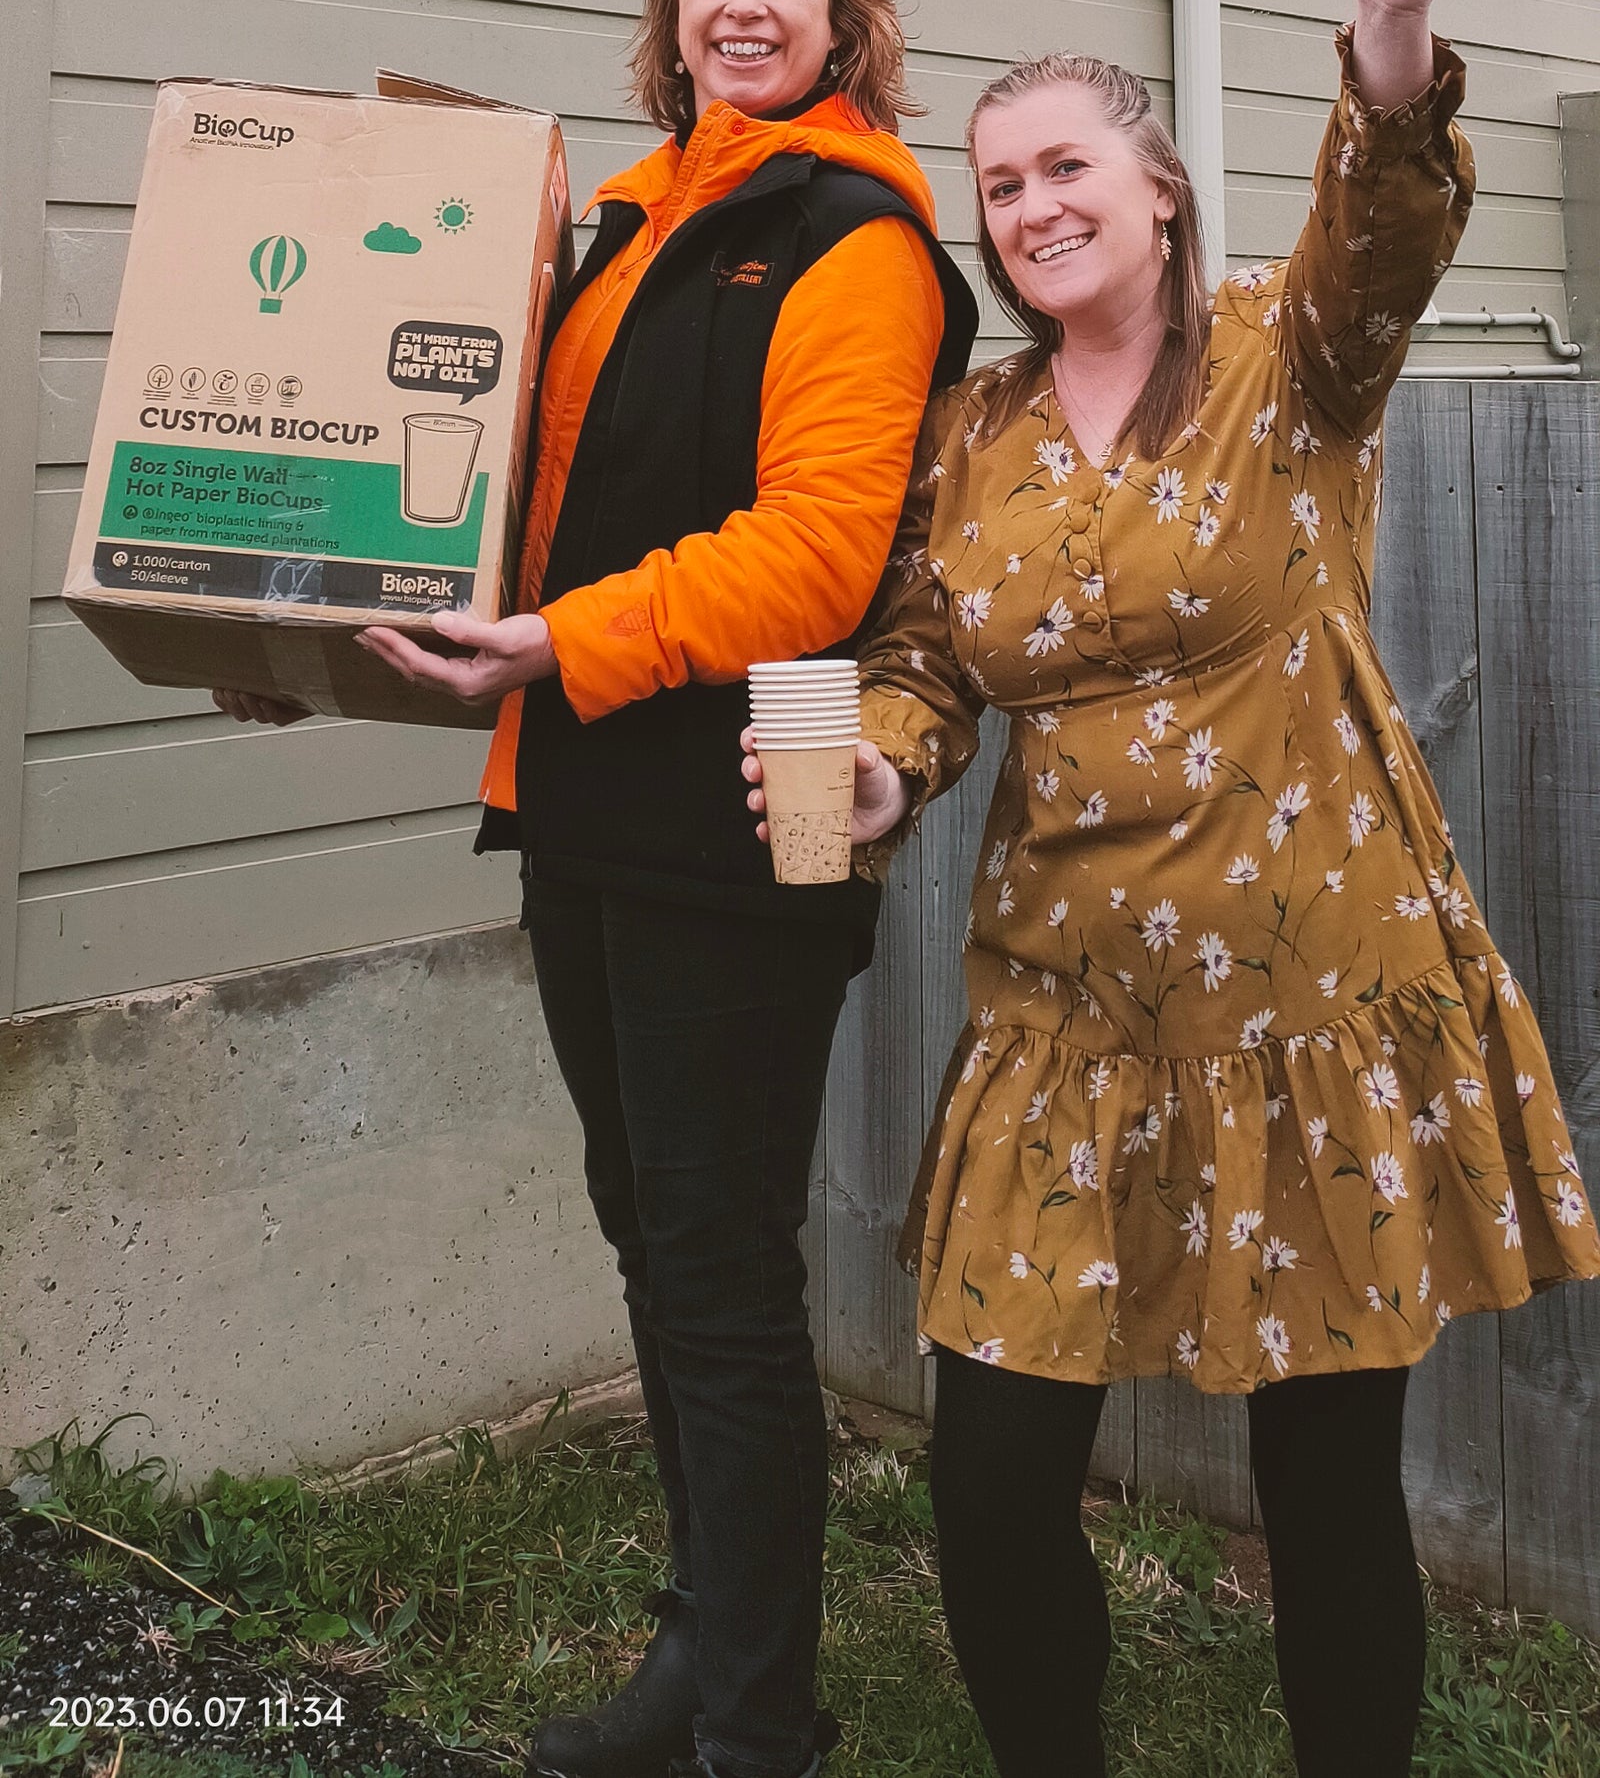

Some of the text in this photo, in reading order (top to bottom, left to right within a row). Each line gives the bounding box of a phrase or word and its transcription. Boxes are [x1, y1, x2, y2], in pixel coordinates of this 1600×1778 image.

[193, 112, 295, 148] BioCup
[399, 332, 497, 350] I'M MADE FROM
[395, 343, 495, 368] PLANTS
[393, 362, 479, 384] NOT OIL
[139, 406, 380, 447] CUSTOM BIOCUP
[129, 456, 168, 475] 8oz
[172, 459, 237, 483] Single
[126, 478, 324, 510] Hot Paper BioCups
[140, 525, 175, 536] paper
[179, 526, 208, 538] from
[211, 531, 269, 544] managed
[196, 512, 255, 528] bioplastic
[258, 517, 293, 533] lining
[130, 569, 189, 585] 50/sleeve
[382, 573, 455, 597] BioPak
